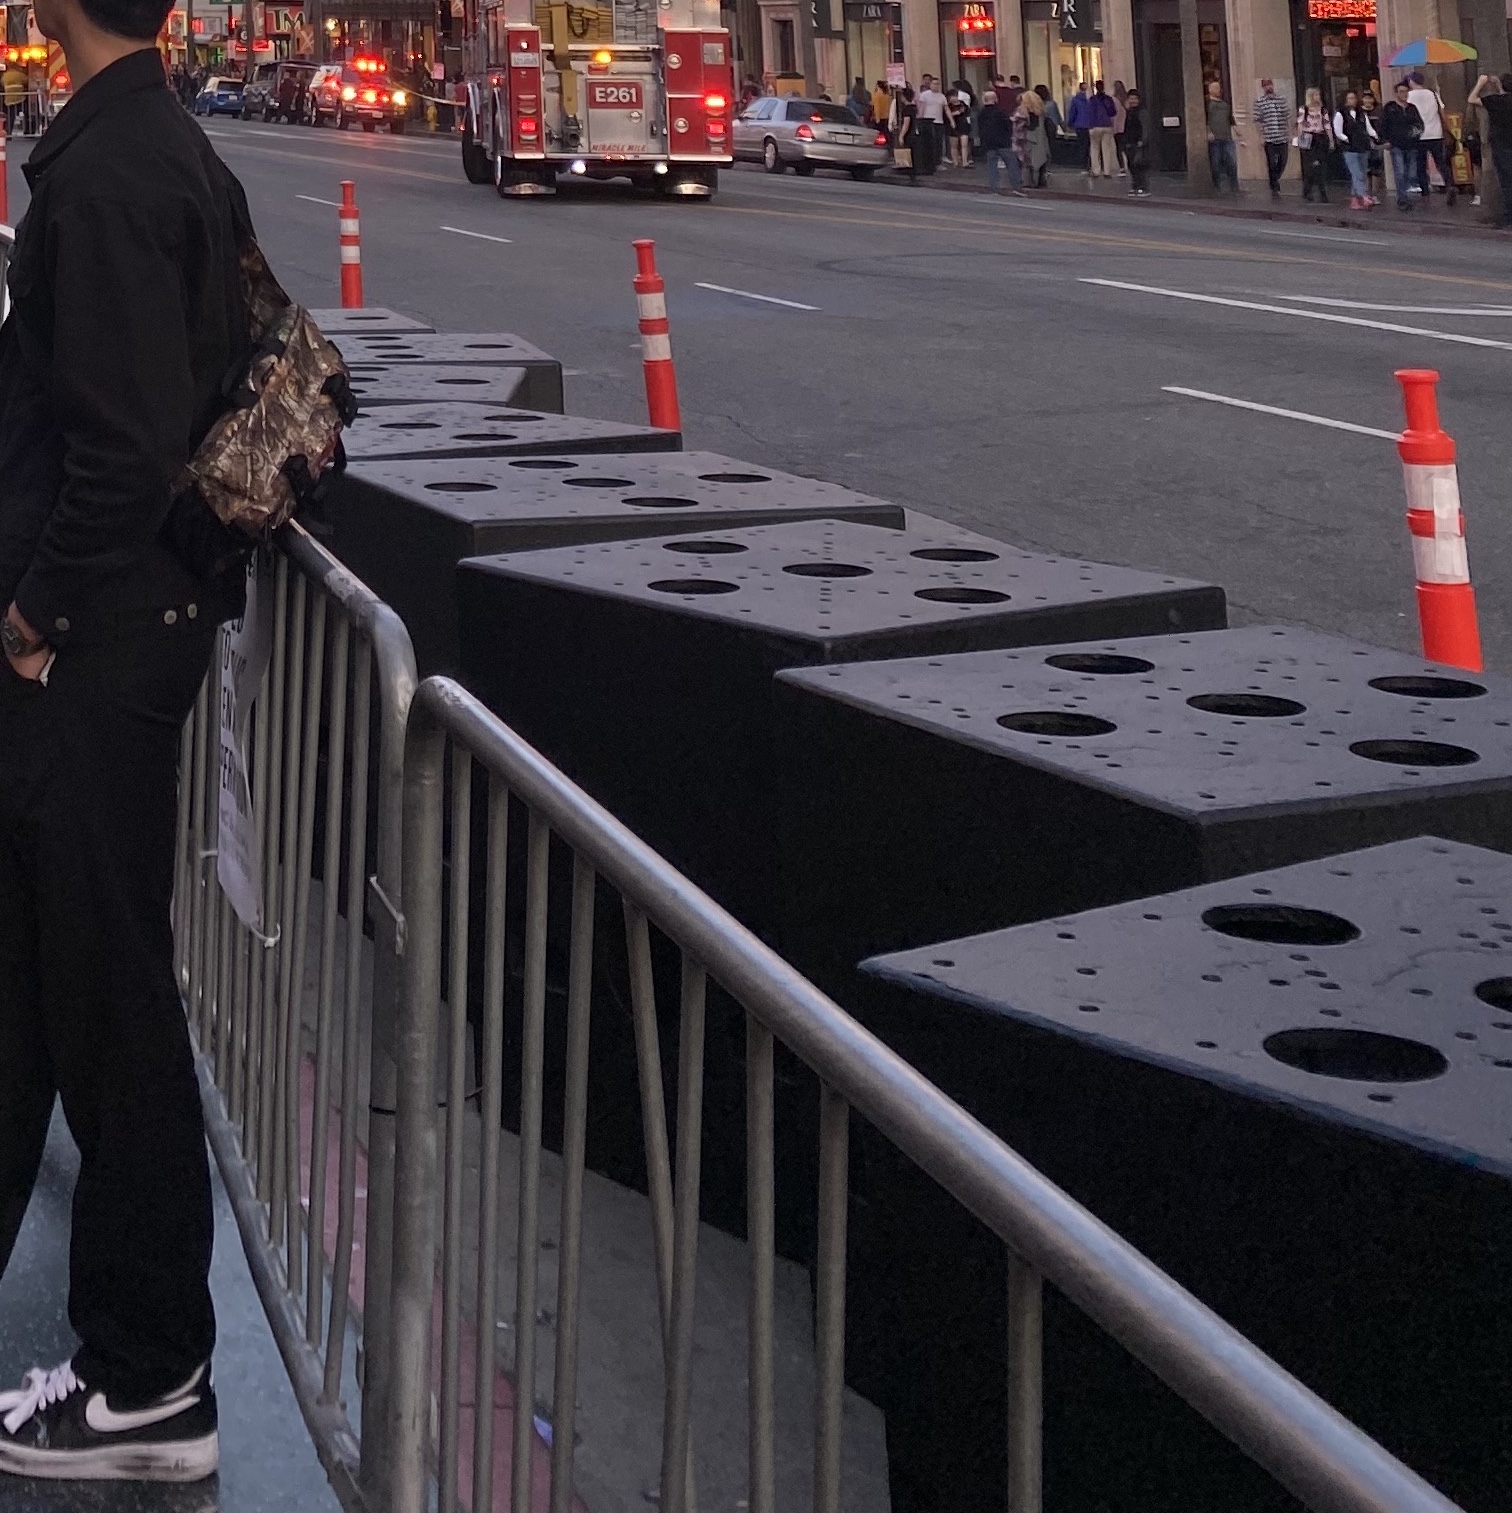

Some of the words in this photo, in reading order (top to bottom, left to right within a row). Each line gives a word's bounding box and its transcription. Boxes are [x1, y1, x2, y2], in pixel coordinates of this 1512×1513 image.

[862, 4, 882, 18] ZARA
[963, 3, 987, 17] ZARA
[595, 87, 637, 103] E261
[591, 143, 626, 152] MIRACLE
[627, 143, 648, 152] MILE
